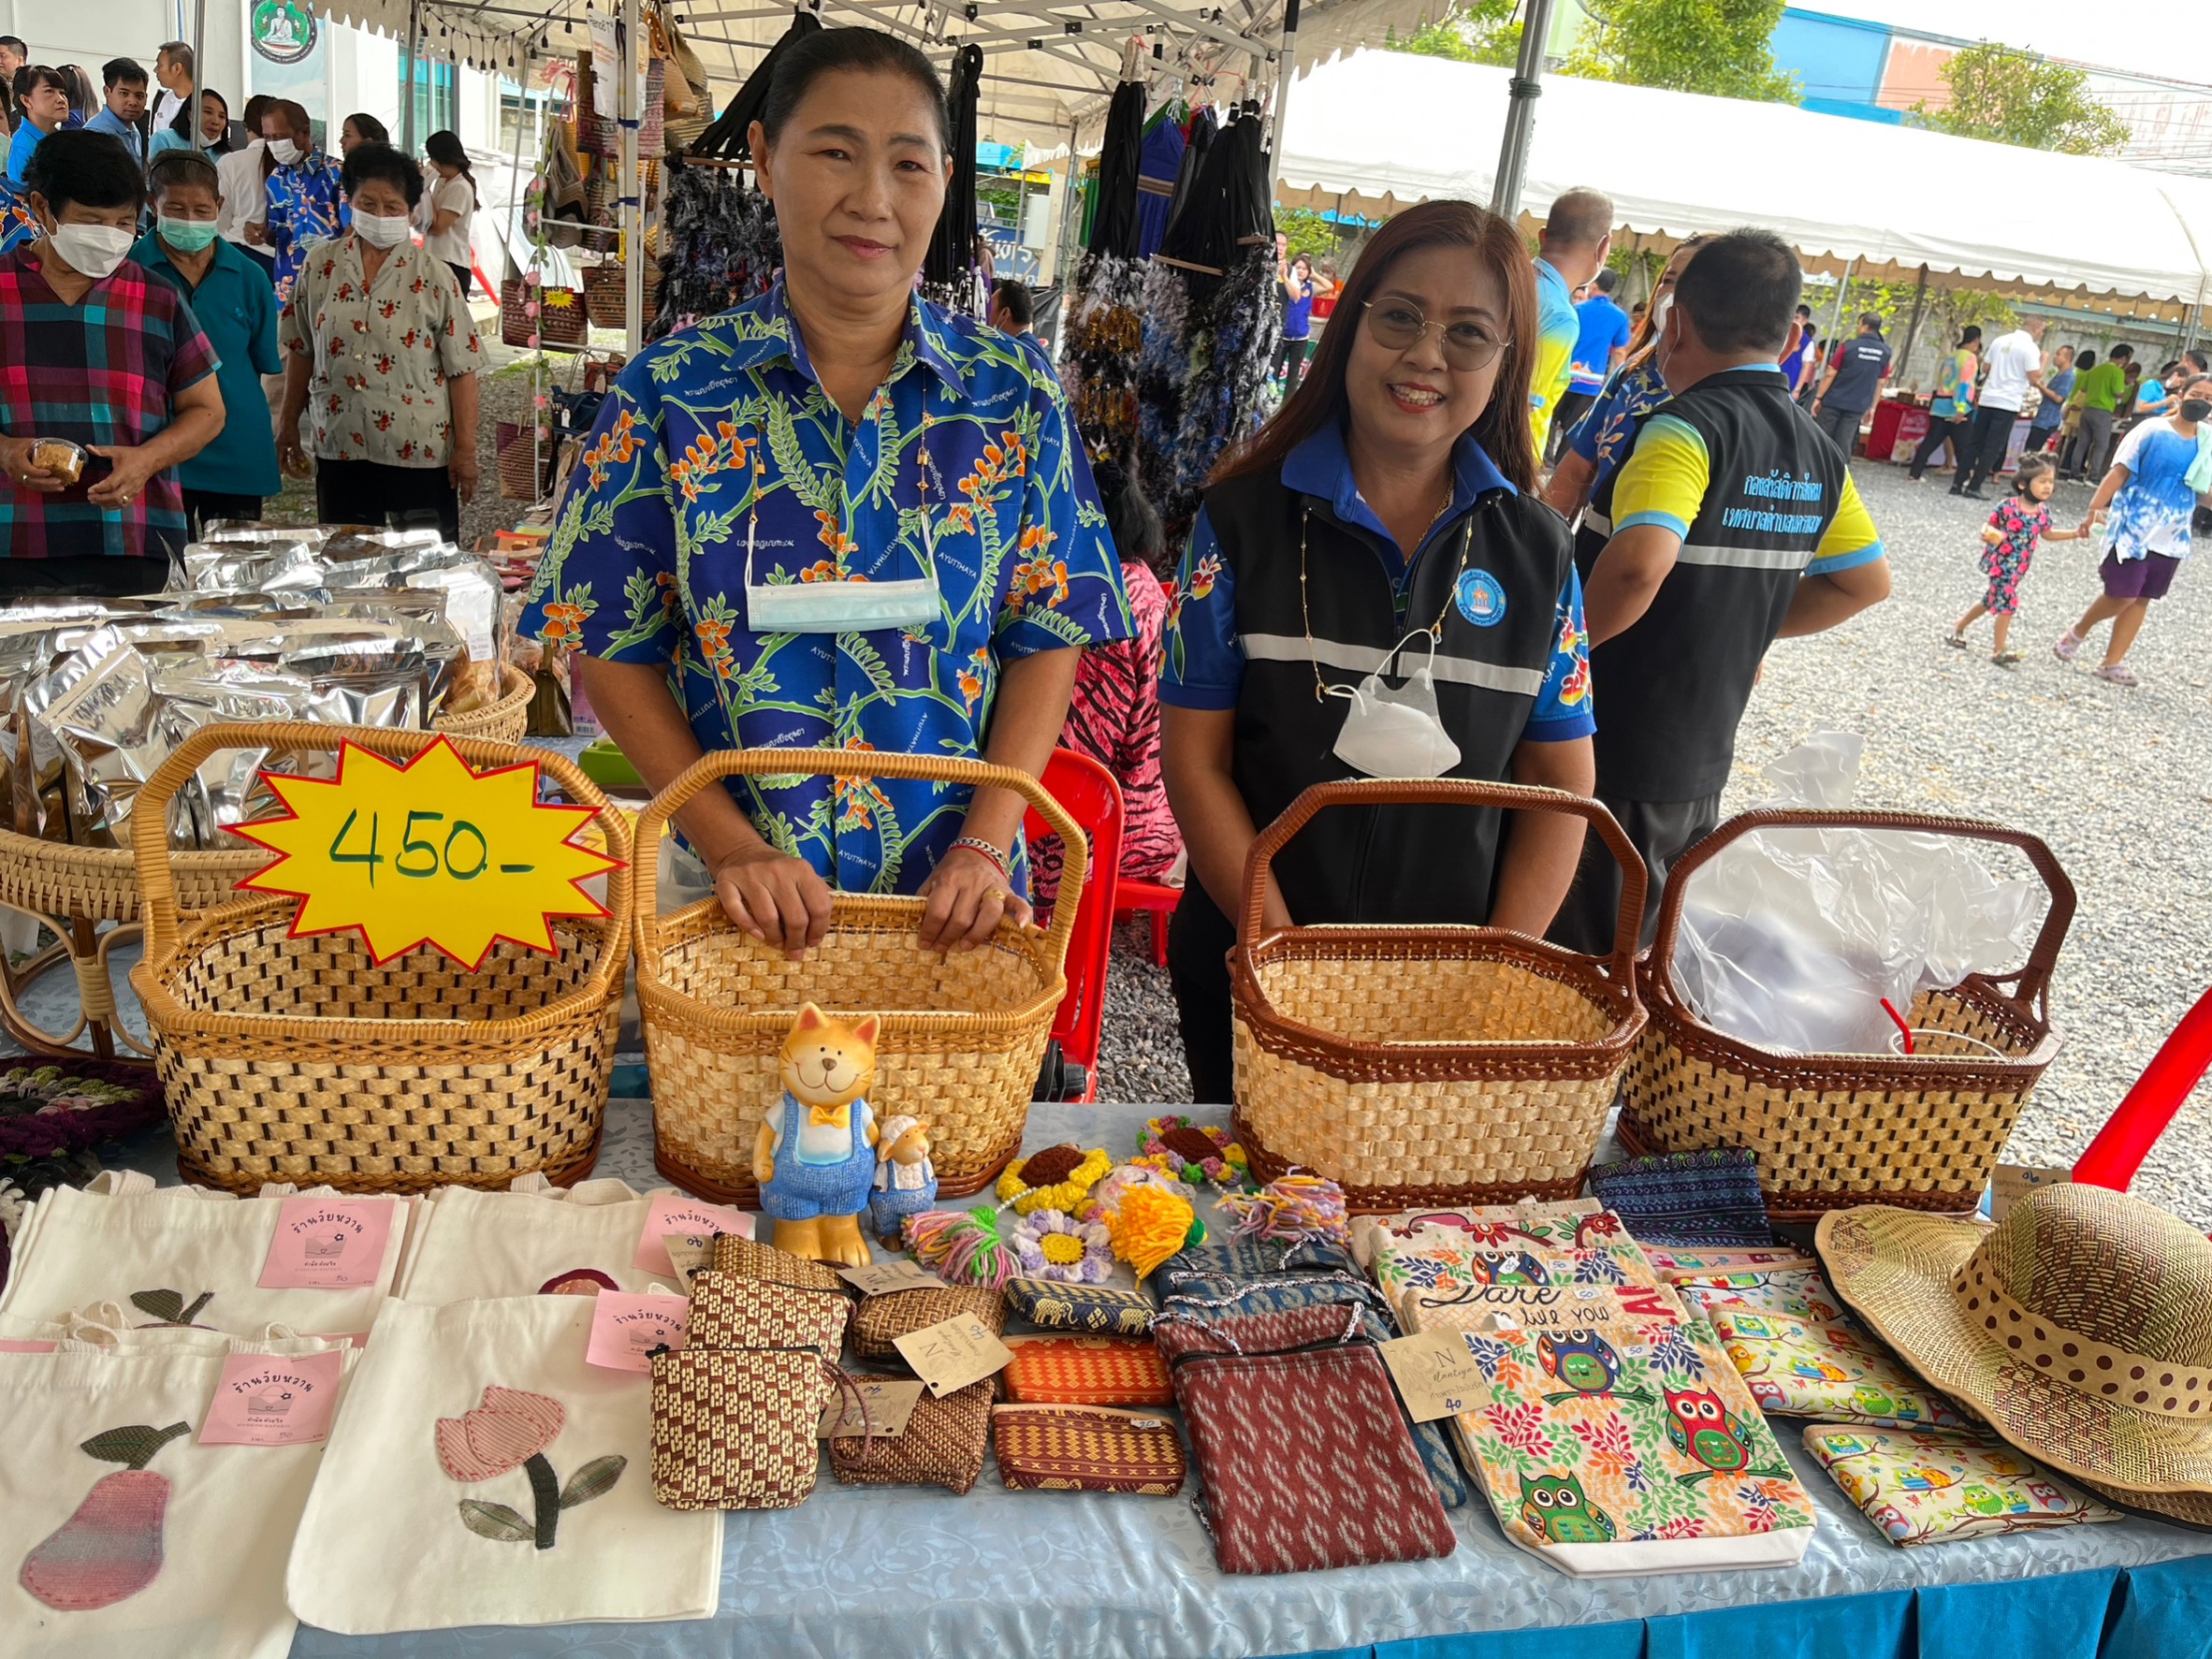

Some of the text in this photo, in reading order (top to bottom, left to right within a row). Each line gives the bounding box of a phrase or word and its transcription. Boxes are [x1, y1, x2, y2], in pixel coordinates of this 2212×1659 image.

[867, 535, 900, 575] AYUTTHAYA
[938, 552, 978, 579] AYUTTHAYA
[837, 850, 878, 870] AYUTTHAYA
[291, 1209, 364, 1234] ร้านวัยหวาน
[664, 1210, 723, 1233] ร้านวัยหวา
[613, 1308, 682, 1332] ร้านวัยหวาน
[919, 1342, 944, 1358] N
[1433, 1347, 1456, 1368] N
[1629, 1346, 1643, 1354] 50
[232, 1370, 313, 1394] ร้านวัยหวาน
[1446, 1398, 1462, 1412] 40
